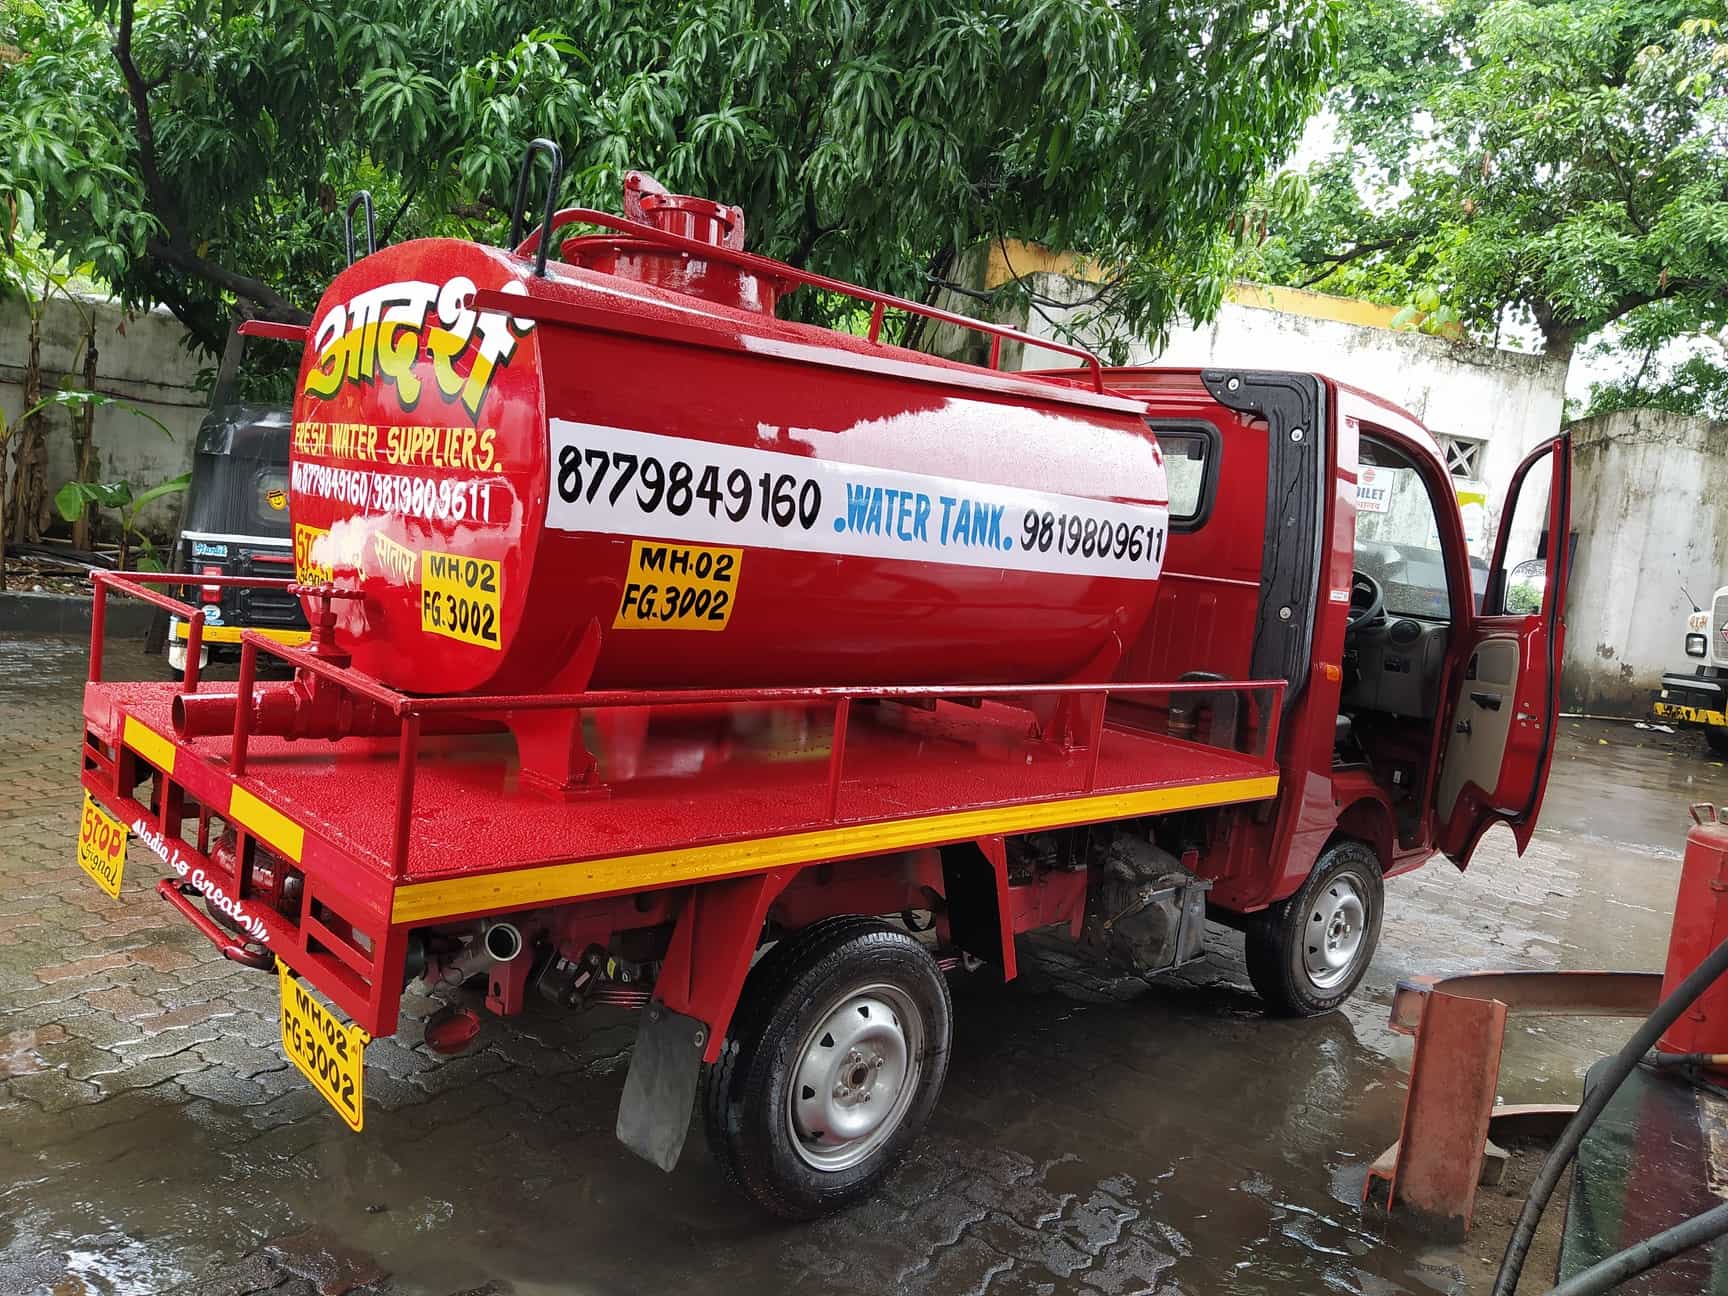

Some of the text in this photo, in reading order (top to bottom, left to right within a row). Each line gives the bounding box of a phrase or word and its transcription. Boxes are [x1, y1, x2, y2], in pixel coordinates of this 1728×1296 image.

[295, 423, 502, 472] FRESH WATER SUPPLIERS.
[557, 445, 822, 530] 8779849160
[939, 495, 1013, 551] TANK.
[1020, 508, 1163, 563] 9819809611
[430, 556, 496, 593] MH.02
[640, 547, 734, 582] MH.02
[423, 590, 497, 642] FG.3002
[621, 584, 729, 621] FG.3002
[82, 807, 122, 862] STOP
[295, 987, 349, 1062] MH.02
[284, 1008, 355, 1114] FG.3002
